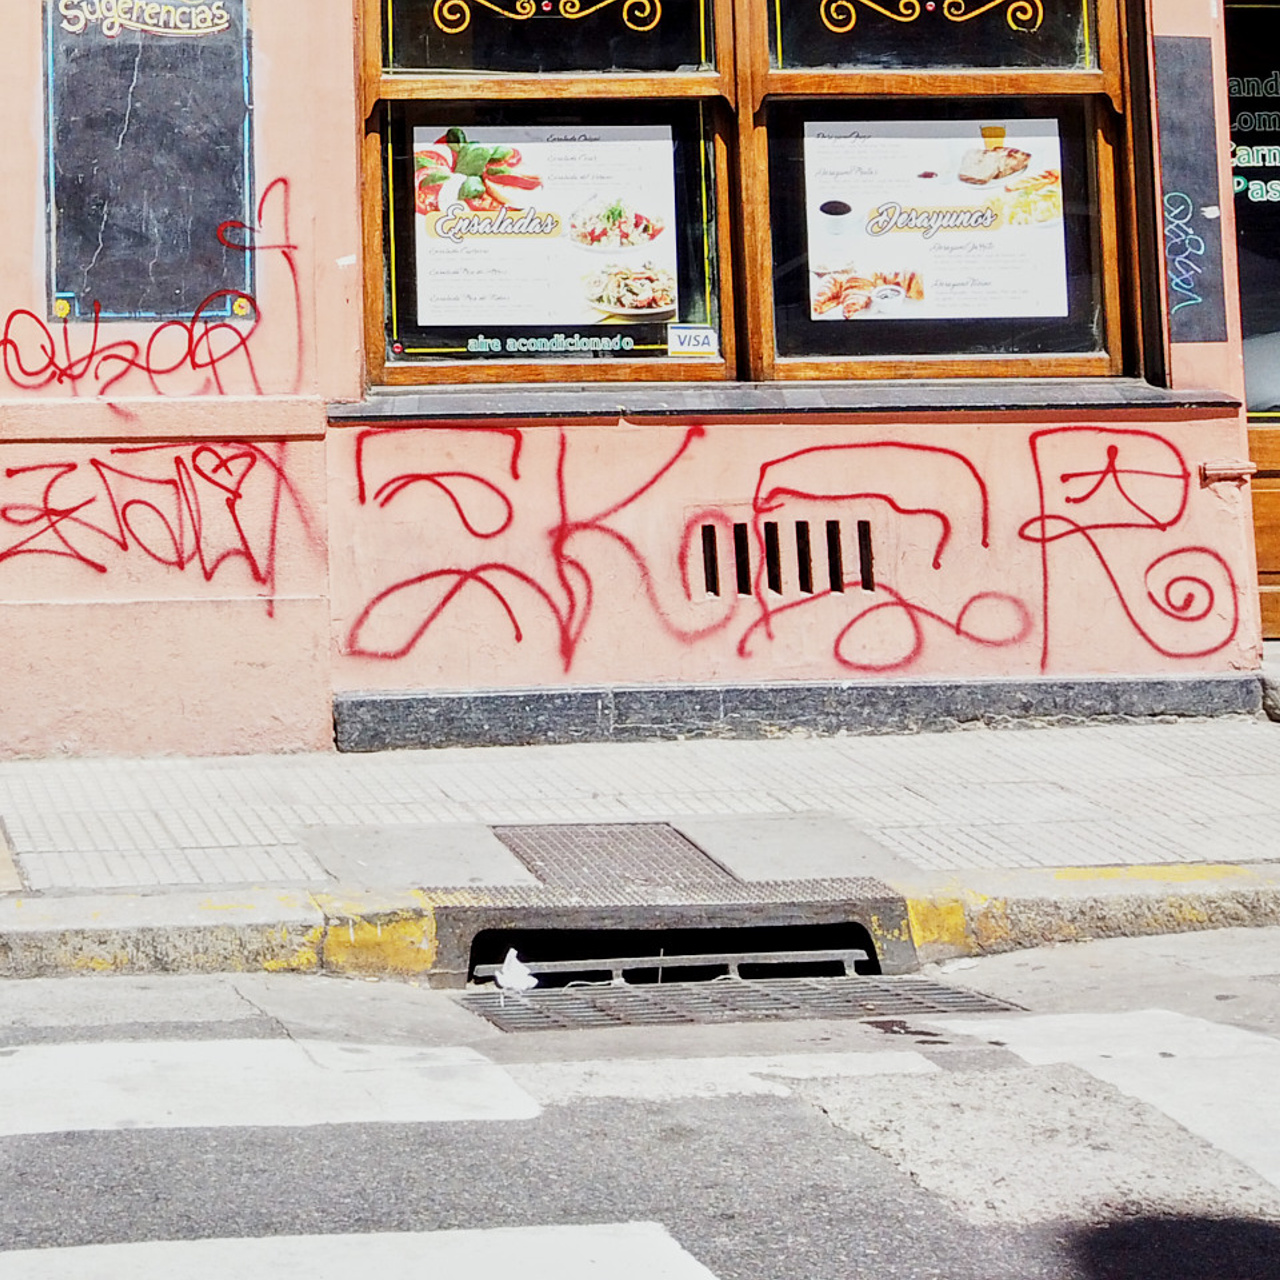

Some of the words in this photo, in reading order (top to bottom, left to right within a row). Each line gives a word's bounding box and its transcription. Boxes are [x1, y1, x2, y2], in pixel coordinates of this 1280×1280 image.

[434, 202, 559, 244] Ensaladas
[865, 201, 999, 240] Desayunos
[467, 333, 502, 352] aire
[505, 332, 635, 352] acondicionado
[676, 333, 711, 348] VISA
